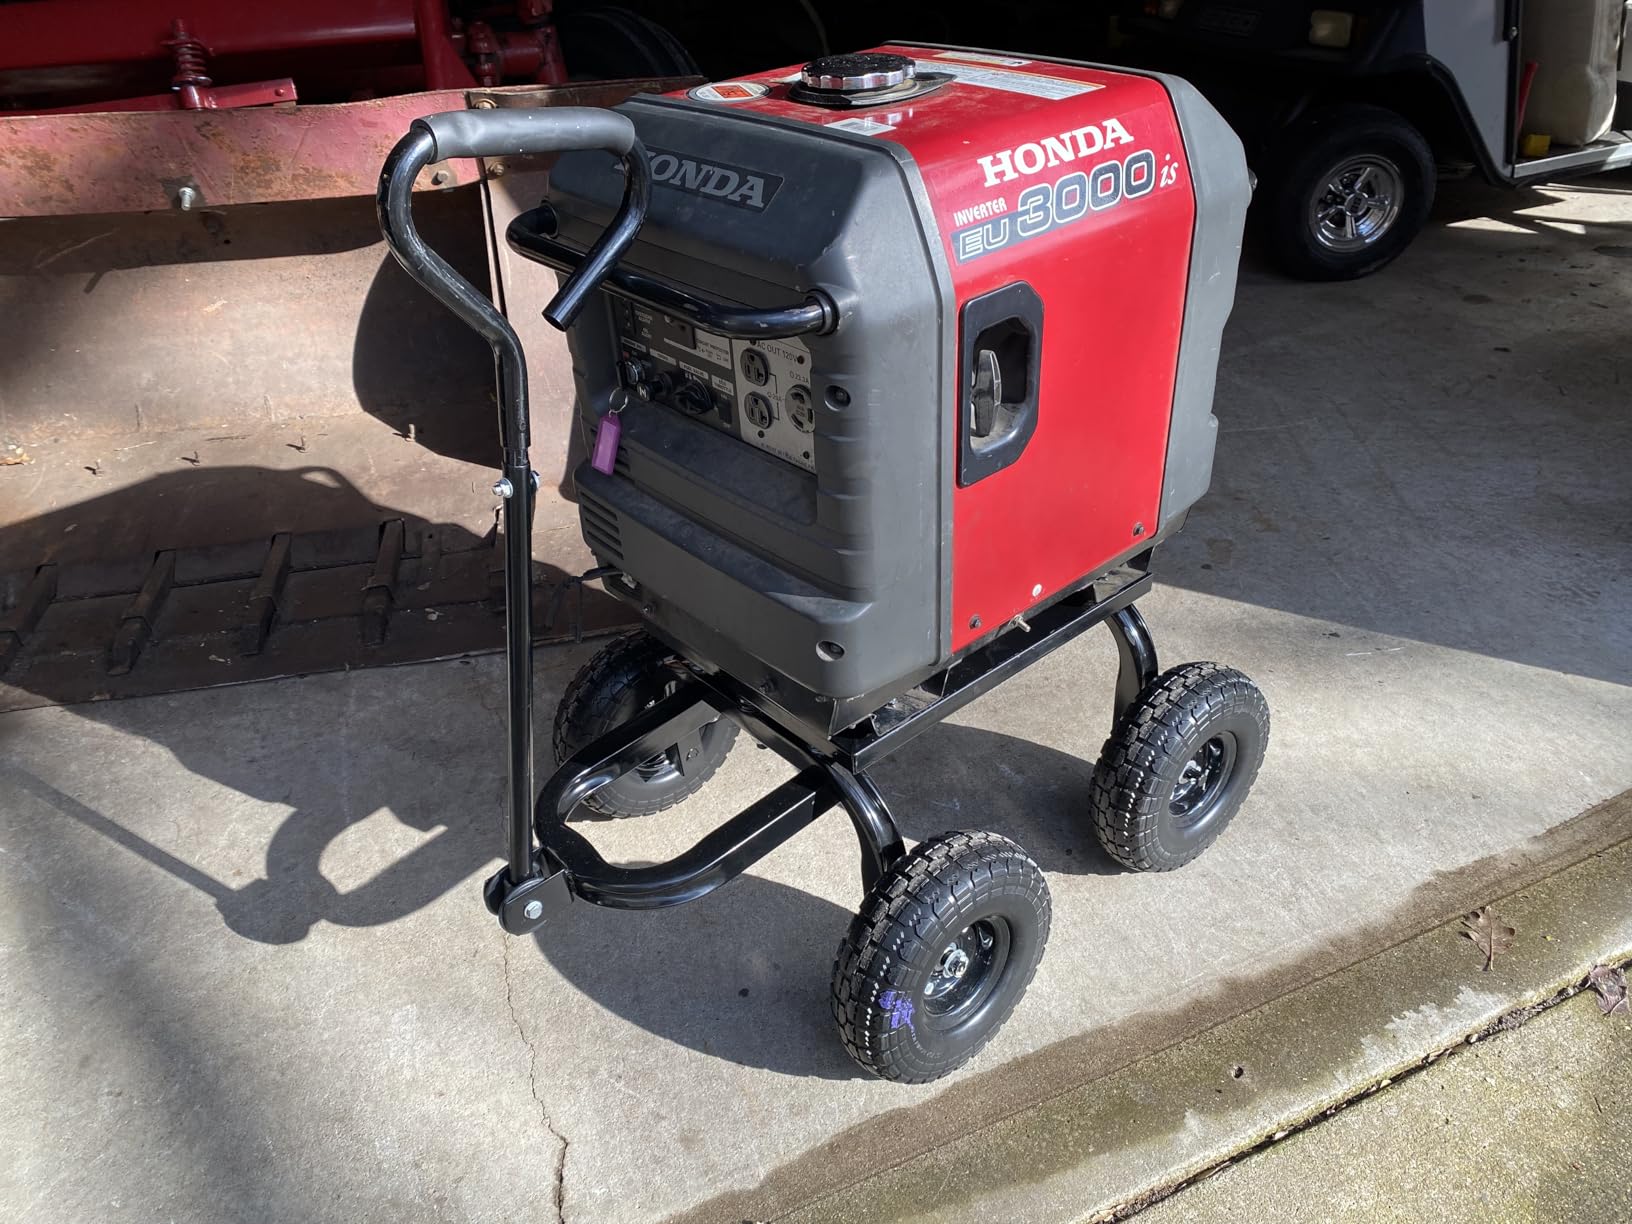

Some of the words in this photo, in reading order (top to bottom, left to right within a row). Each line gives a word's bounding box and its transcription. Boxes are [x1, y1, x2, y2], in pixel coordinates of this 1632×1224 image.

[977, 118, 1134, 187] HONDA
[645, 150, 765, 208] ONDA
[953, 197, 1008, 227] INVERTER
[757, 341, 766, 350] AC
[767, 344, 780, 356] OUT
